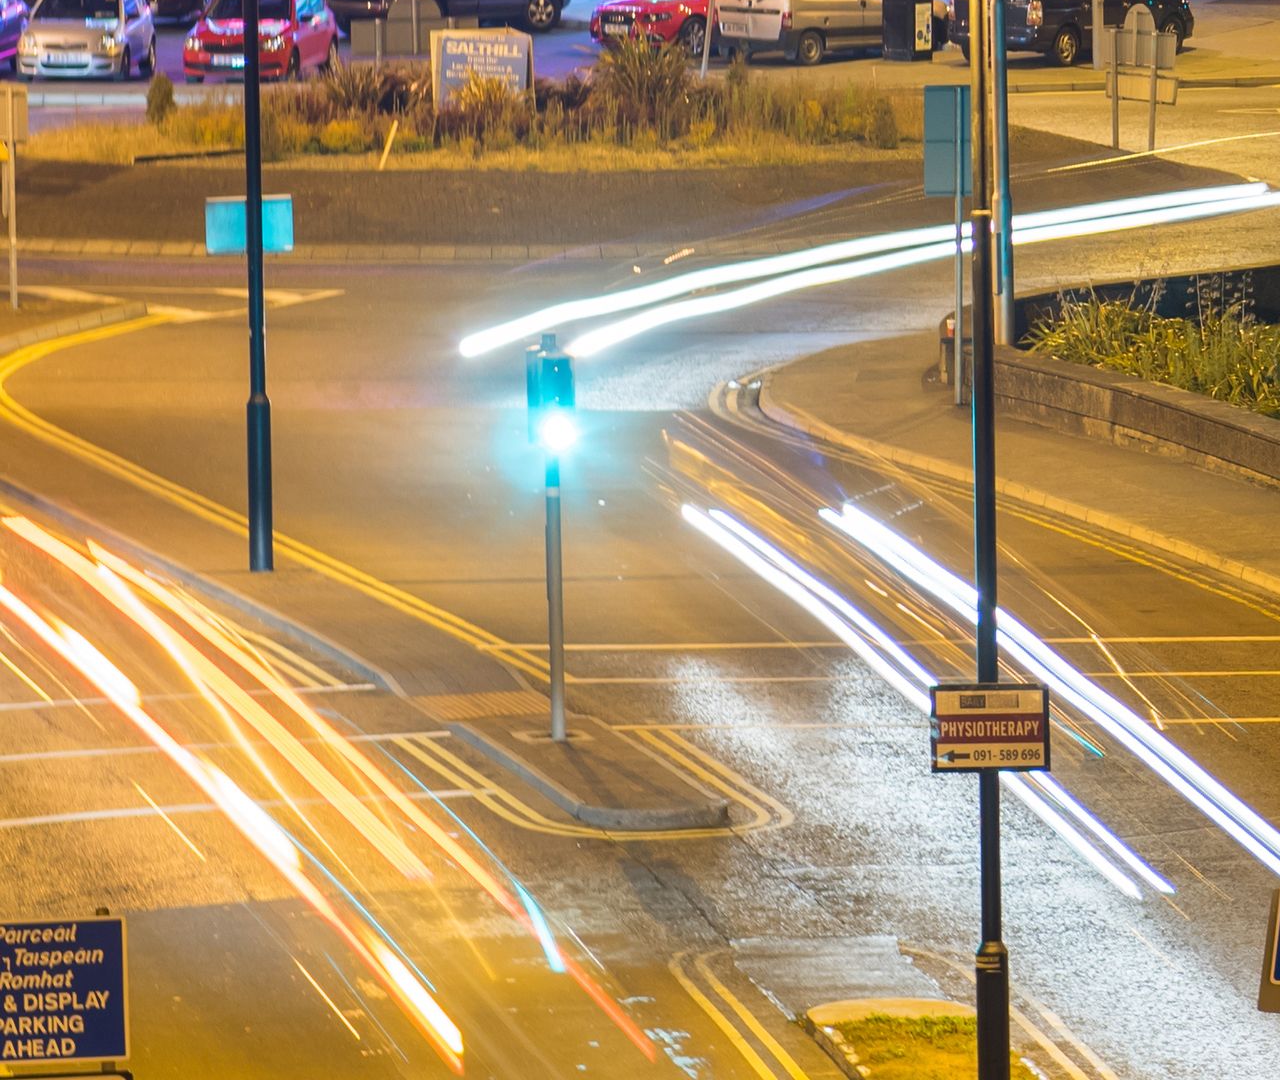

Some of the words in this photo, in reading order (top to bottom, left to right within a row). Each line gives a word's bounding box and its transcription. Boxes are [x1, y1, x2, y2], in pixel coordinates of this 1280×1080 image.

[446, 40, 523, 58] SALTHILL
[940, 720, 1040, 738] PHYSIOTHERAPY
[999, 748, 1019, 761] 589
[1020, 748, 1041, 761] 696
[0, 969, 75, 991] Romhat
[3, 994, 18, 1013] &
[23, 989, 110, 1012] DISPLAY
[2, 1037, 77, 1059] AHEAD
